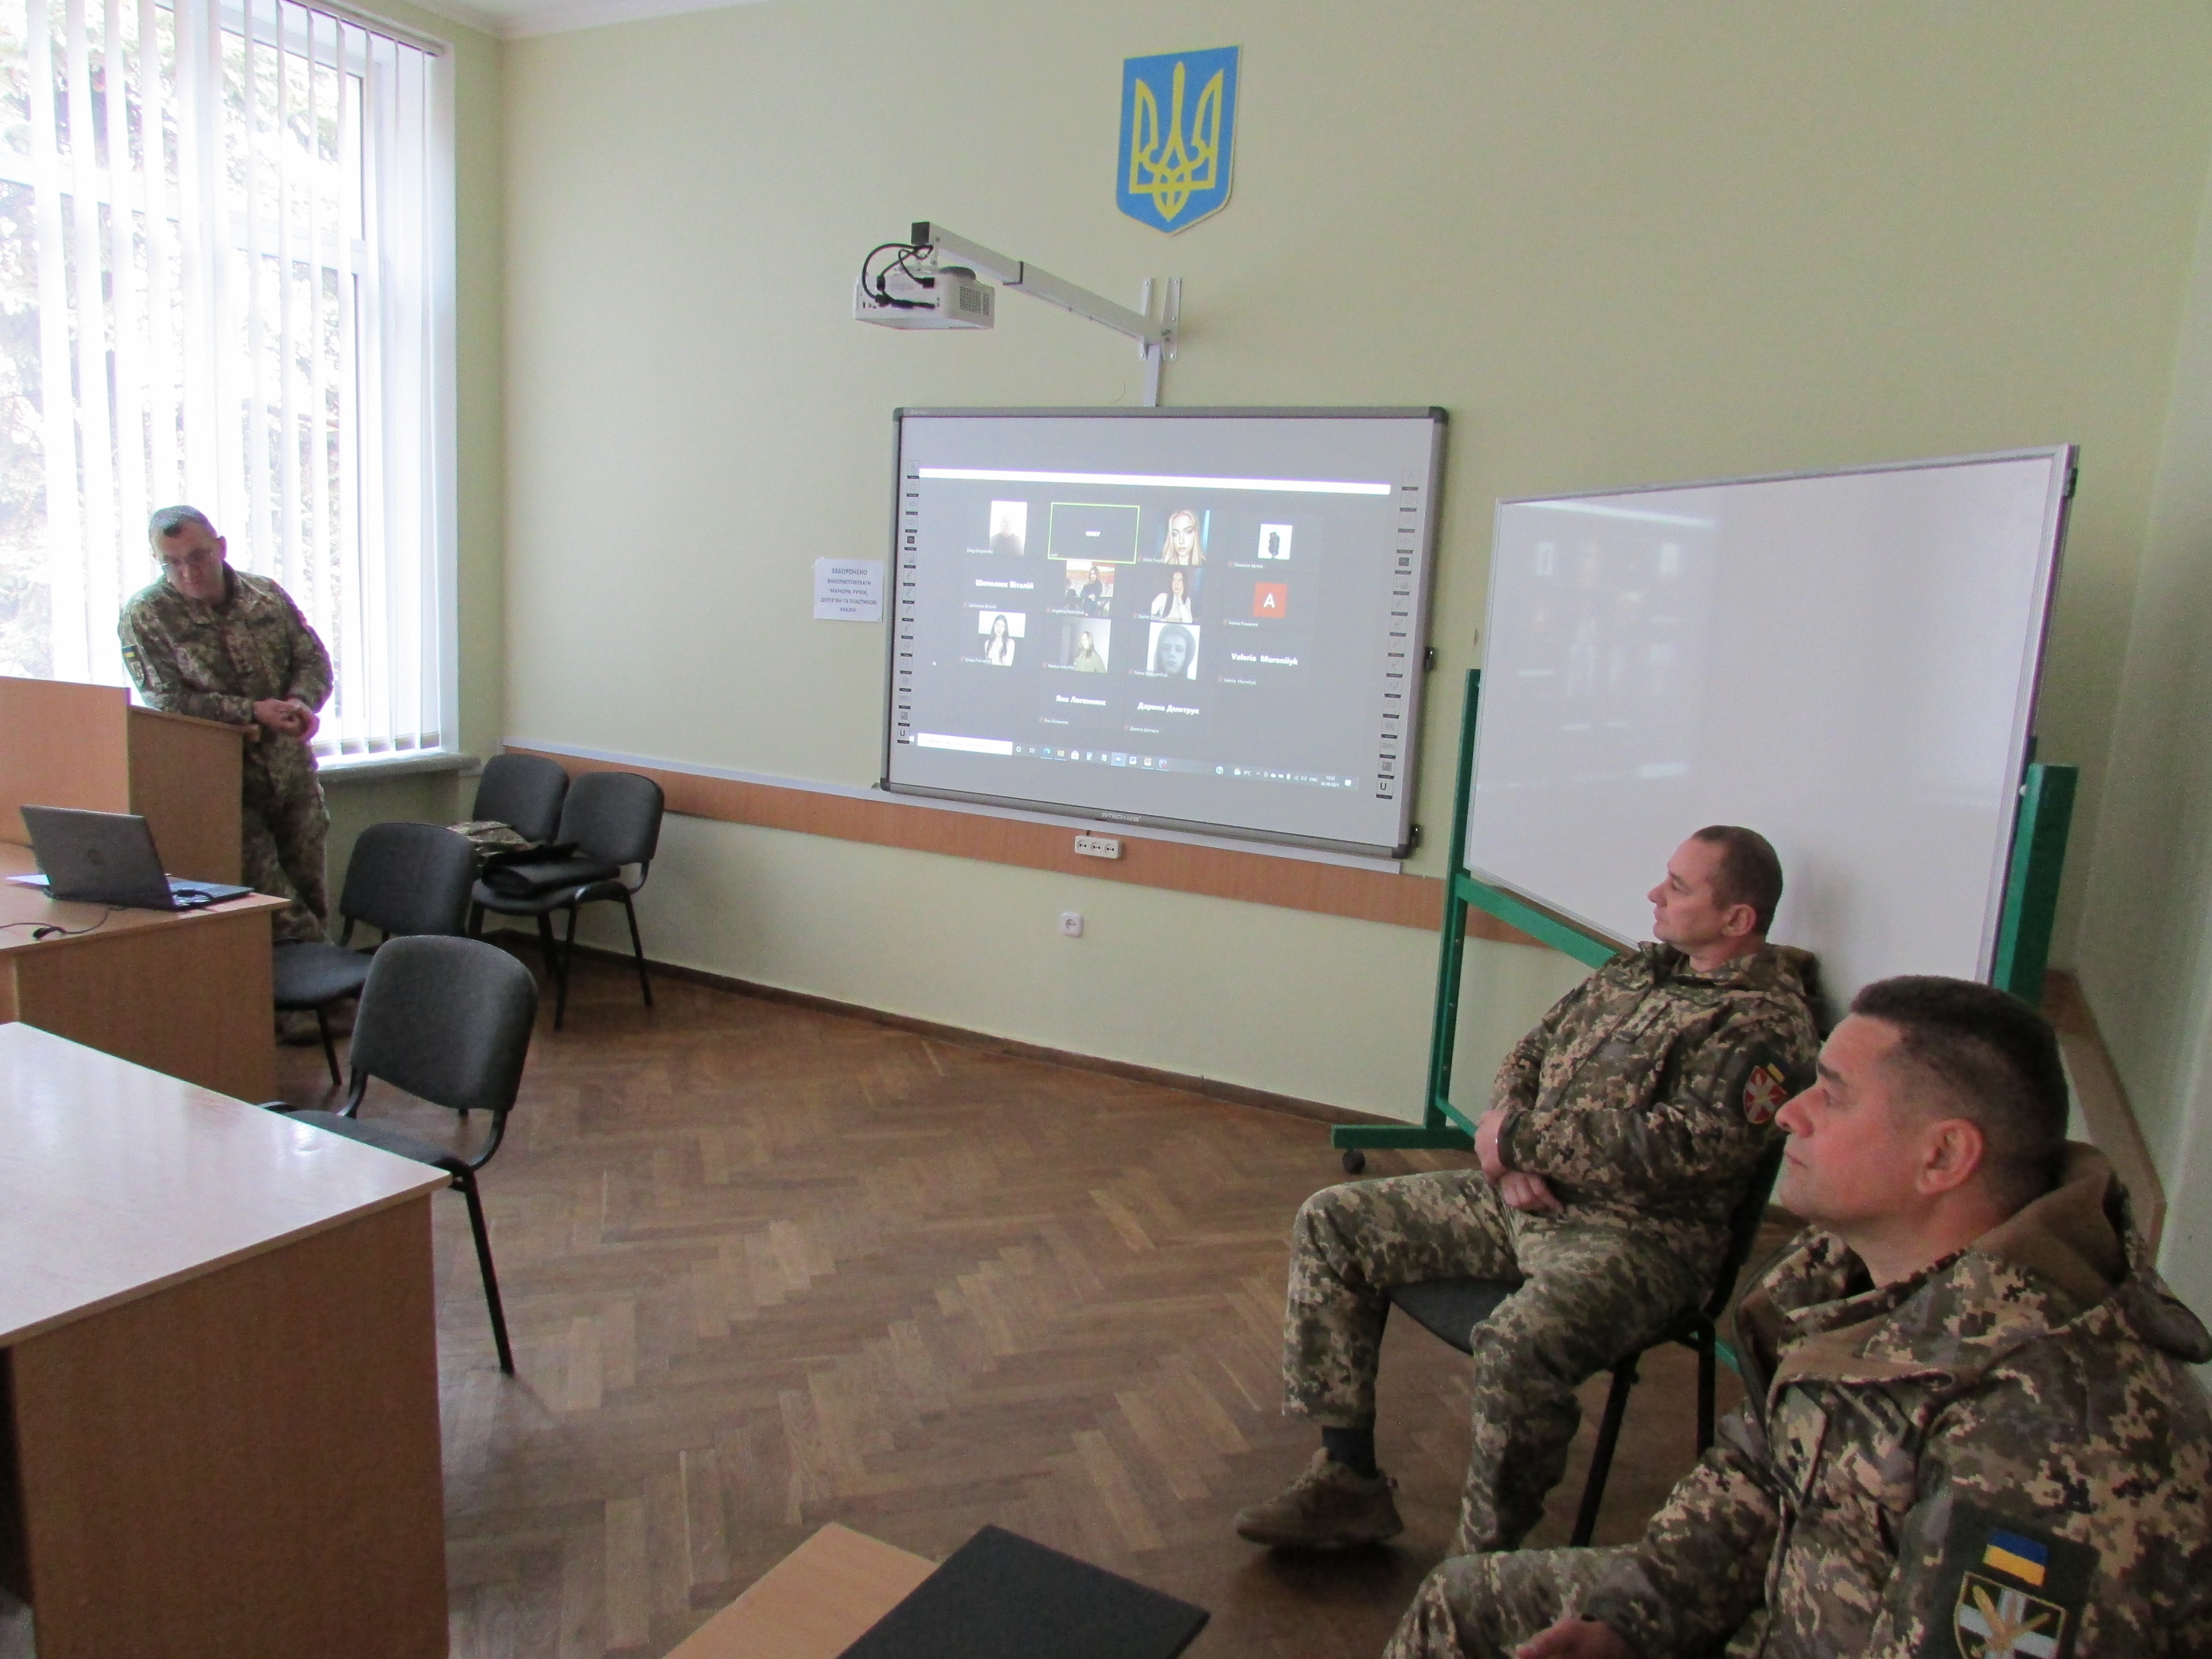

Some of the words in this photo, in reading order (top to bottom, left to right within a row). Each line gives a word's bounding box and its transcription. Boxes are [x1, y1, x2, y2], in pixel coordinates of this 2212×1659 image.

[975, 579, 1009, 588] Шепелюк
[1010, 581, 1034, 589] Віталій
[1231, 653, 1256, 662] Valeria
[1056, 695, 1069, 703] Яна
[1070, 696, 1106, 707] Логвинюк
[1137, 702, 1165, 711] Дарина
[1166, 704, 1200, 716] Дмитрук
